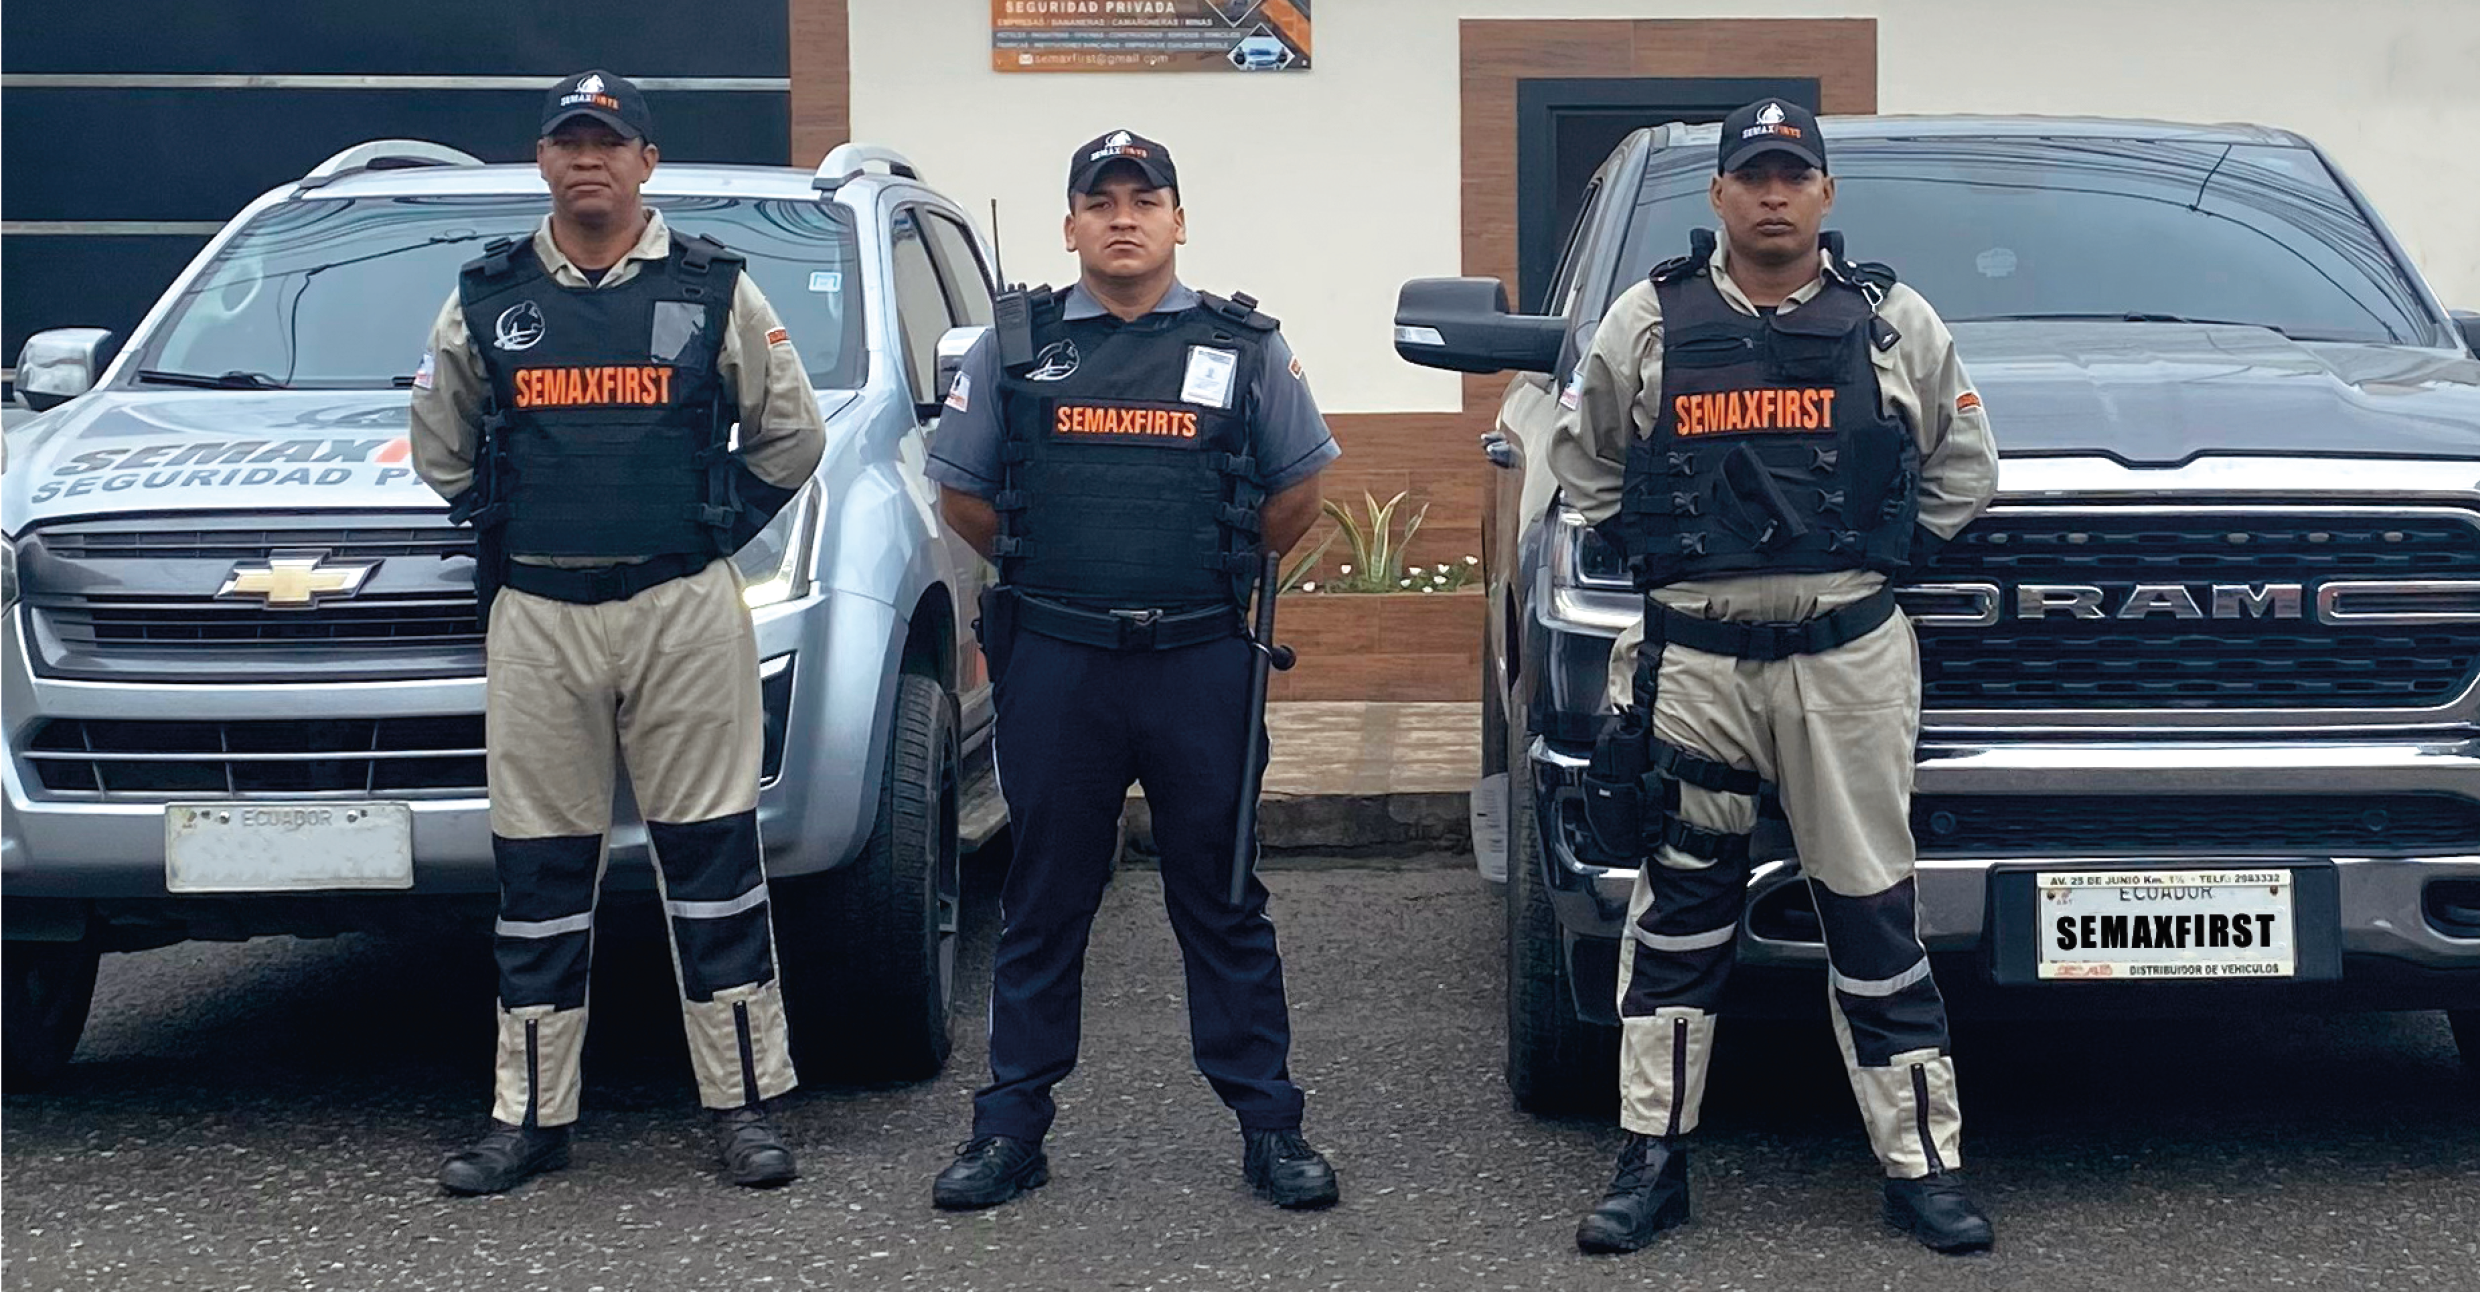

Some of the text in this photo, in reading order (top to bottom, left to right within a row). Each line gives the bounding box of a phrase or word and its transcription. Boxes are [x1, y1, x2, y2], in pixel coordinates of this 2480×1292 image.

[1005, 1, 1176, 13] SEGURIDAD PRIVADA
[1034, 52, 1169, 66] semaxfirst@gmailcom
[515, 366, 672, 408] SEMAXFIRST
[1056, 406, 1198, 439] SEMAXFIRTS
[1674, 388, 1835, 436] SEMAXFIRST
[31, 467, 352, 503] SEGURIDAD
[2017, 584, 2302, 619] RAM
[242, 810, 333, 826] ECUADOR
[2088, 876, 2102, 885] DE
[2105, 875, 2141, 885] JUNIO
[2056, 913, 2275, 950] SEMAXFIRST
[2129, 964, 2202, 976] DISTRIBUIDOR
[2205, 964, 2219, 975] DE
